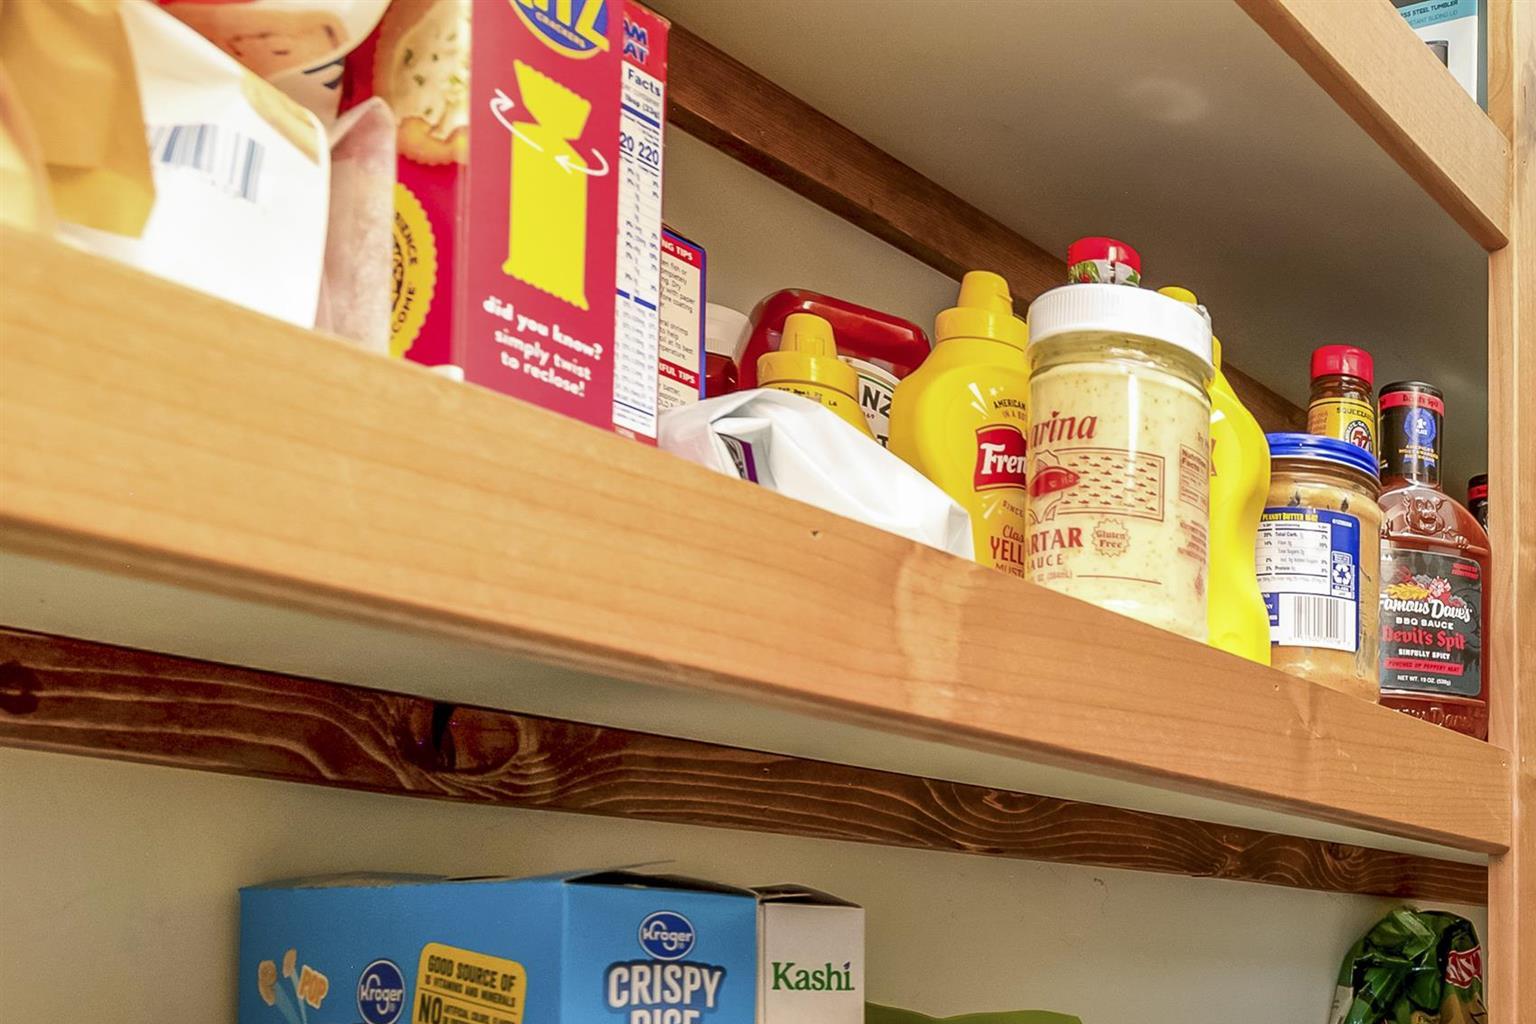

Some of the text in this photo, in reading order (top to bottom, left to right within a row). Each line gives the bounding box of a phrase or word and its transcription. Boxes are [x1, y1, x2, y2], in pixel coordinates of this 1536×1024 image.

[628, 68, 662, 97] Facts
[639, 142, 660, 166] 220
[676, 246, 693, 261] TIPS
[483, 295, 605, 361] did you know?
[494, 327, 592, 381] simply twist
[501, 350, 587, 398] to reclose!
[678, 370, 696, 385] TIPS
[1352, 430, 1372, 448] 57
[1096, 529, 1126, 541] Gluten
[1099, 539, 1123, 549] Free
[1396, 616, 1454, 631] BBQ SAUCE
[1431, 599, 1472, 623] Dave's
[1382, 625, 1466, 651] Devil's Spit
[1398, 649, 1451, 660] SINFULLY SPICY
[643, 920, 692, 951] Kroger
[428, 954, 516, 991] GOOD SOURCE OF
[771, 961, 855, 991] Kashi
[361, 974, 403, 1014] Kroger
[608, 964, 722, 1008] CRISPY
